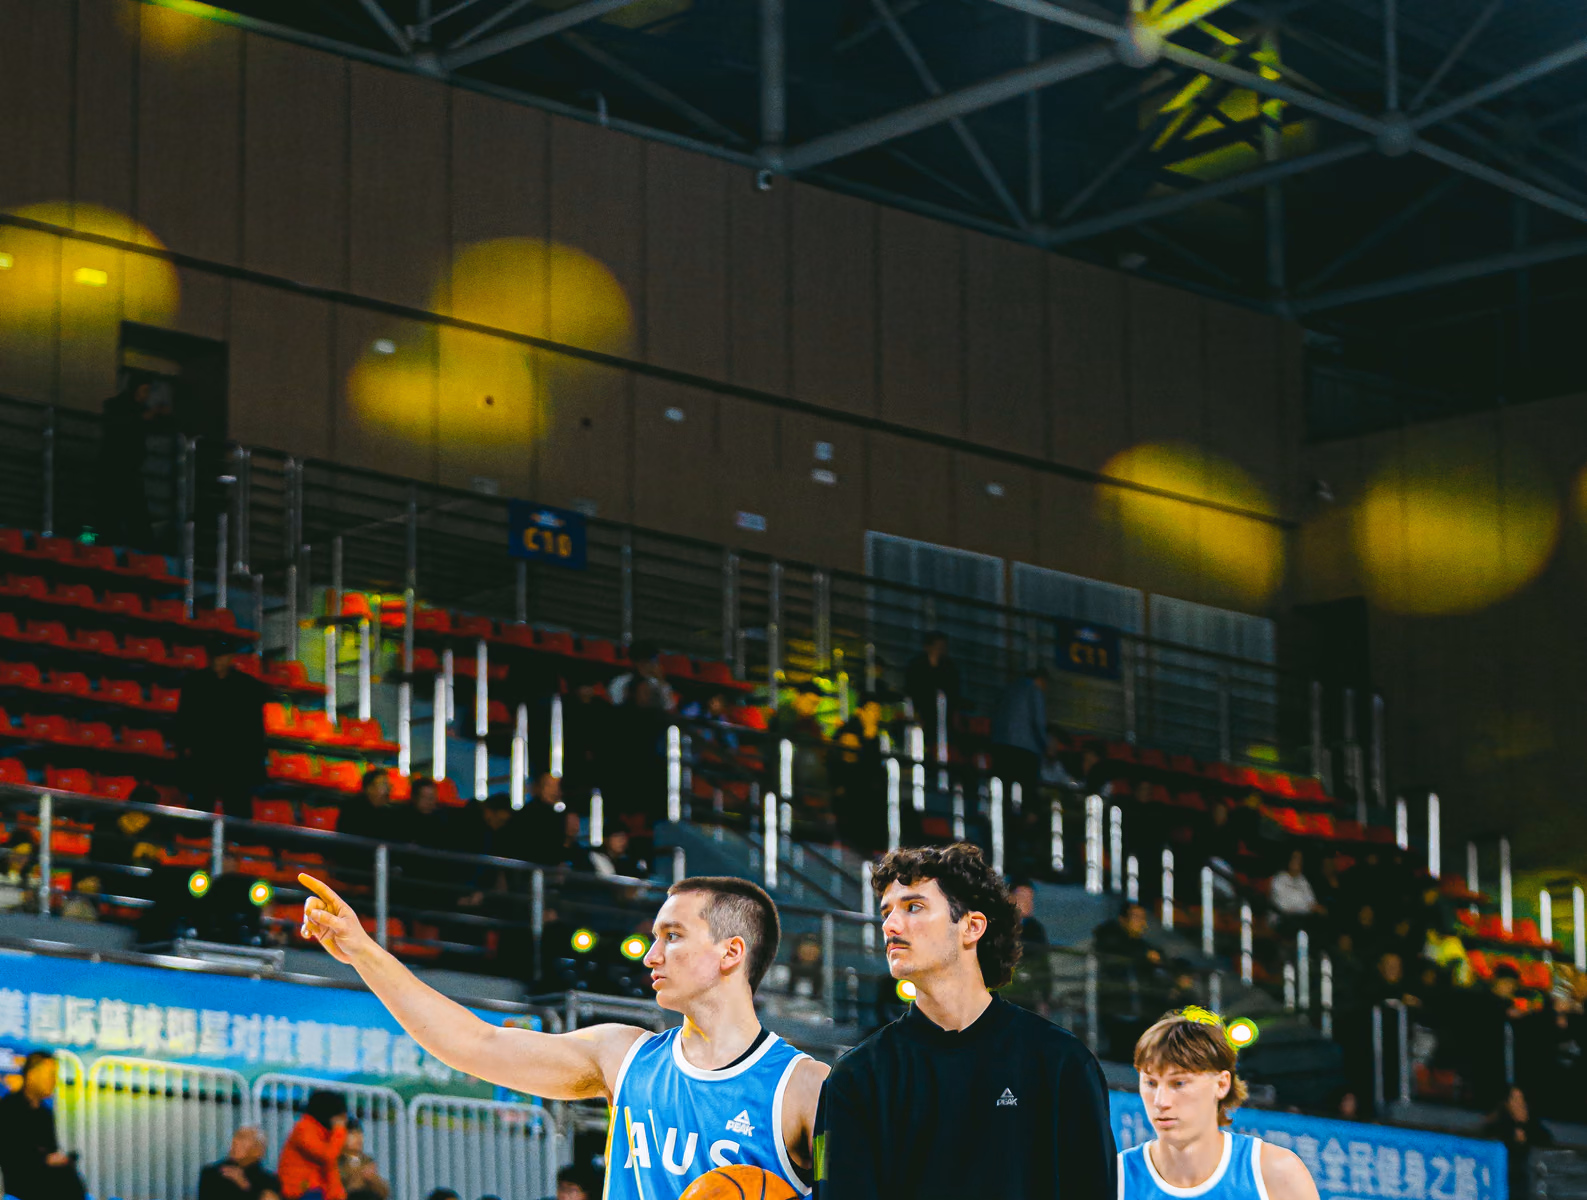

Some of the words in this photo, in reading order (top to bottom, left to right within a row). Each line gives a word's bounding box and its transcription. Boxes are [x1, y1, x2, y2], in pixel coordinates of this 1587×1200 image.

[522, 526, 573, 558] C10
[996, 1098, 1018, 1106] PEAK
[725, 1119, 756, 1137] PEAK
[624, 1121, 741, 1176] AUS
